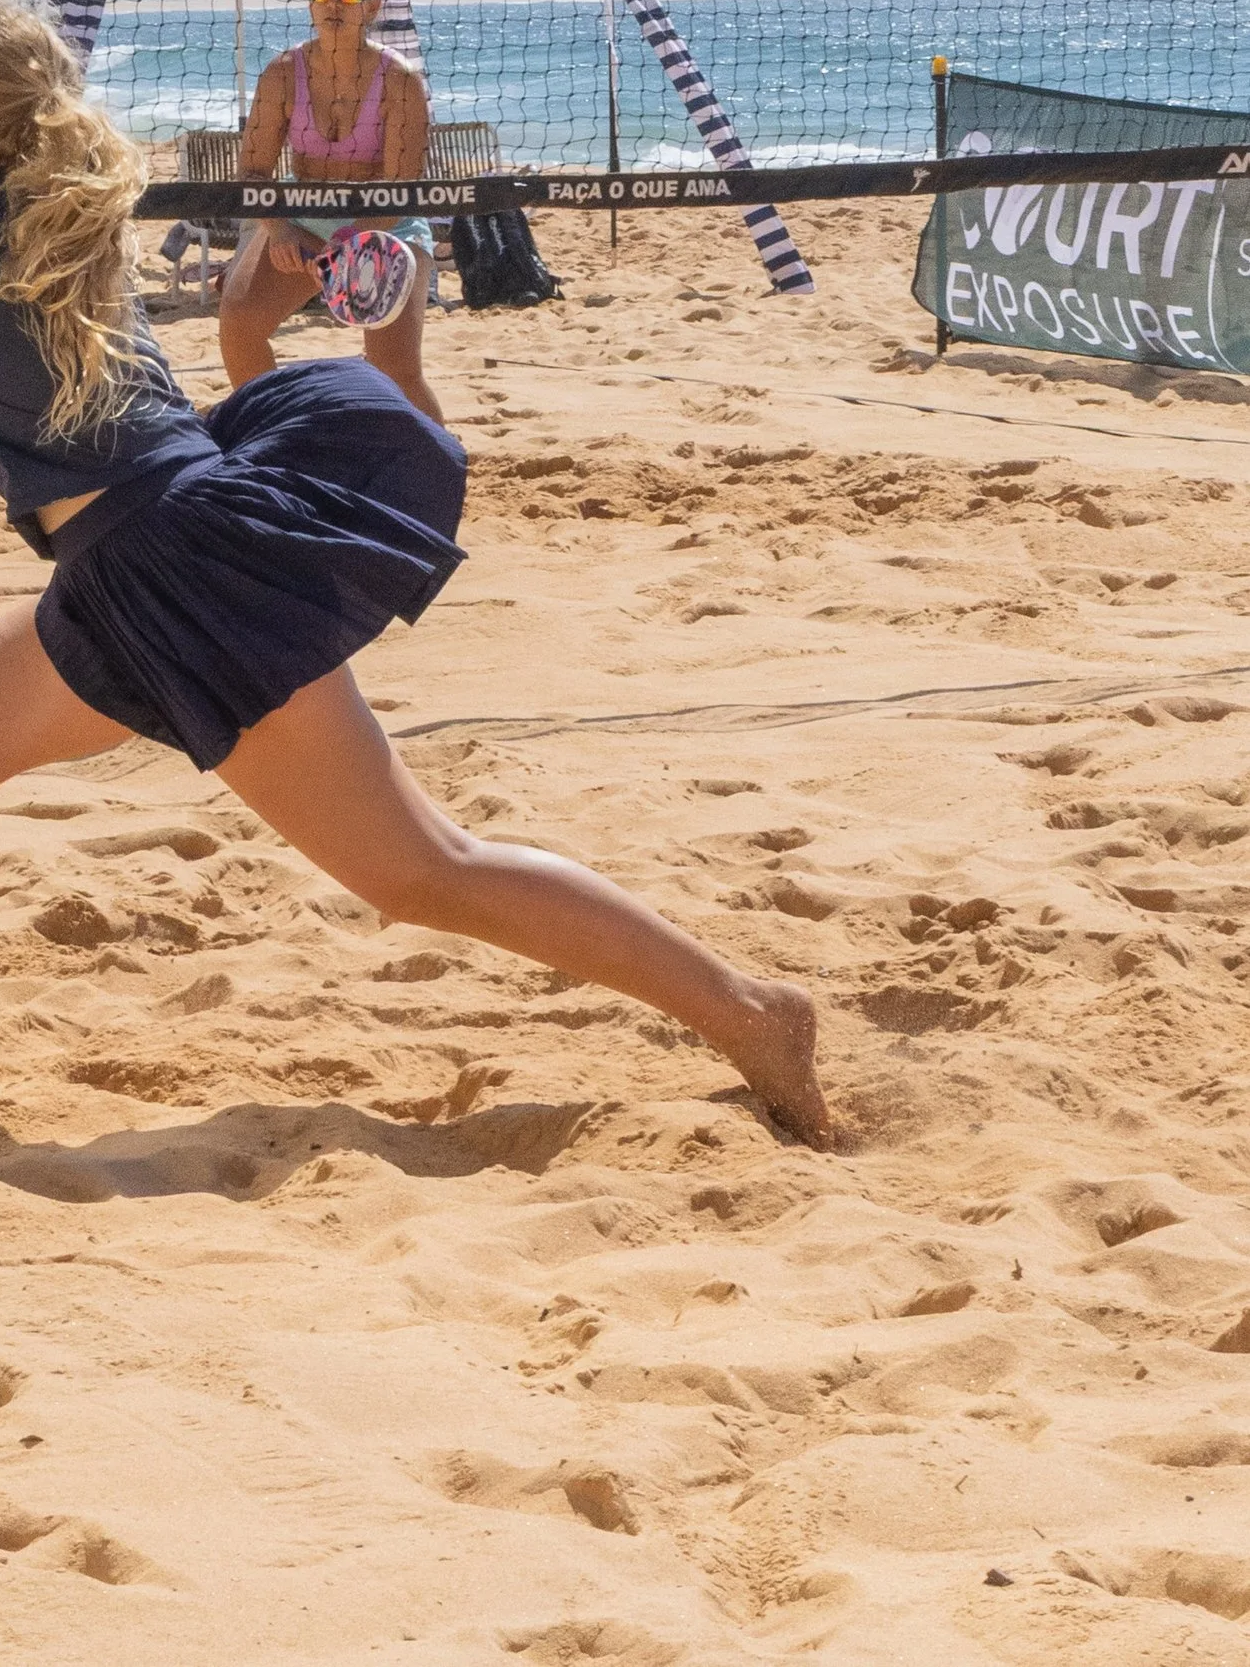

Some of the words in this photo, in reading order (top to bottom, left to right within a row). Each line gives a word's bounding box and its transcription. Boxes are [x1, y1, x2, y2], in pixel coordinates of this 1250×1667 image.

[242, 188, 277, 207] DO
[284, 189, 352, 207] WHAT
[359, 188, 409, 207] YOU
[416, 185, 476, 205] LOVE
[548, 182, 602, 204] FAÇA
[608, 181, 625, 199] O
[631, 180, 678, 199] QUE
[684, 179, 731, 197] AMA
[945, 261, 1217, 363] EXPOSURE
